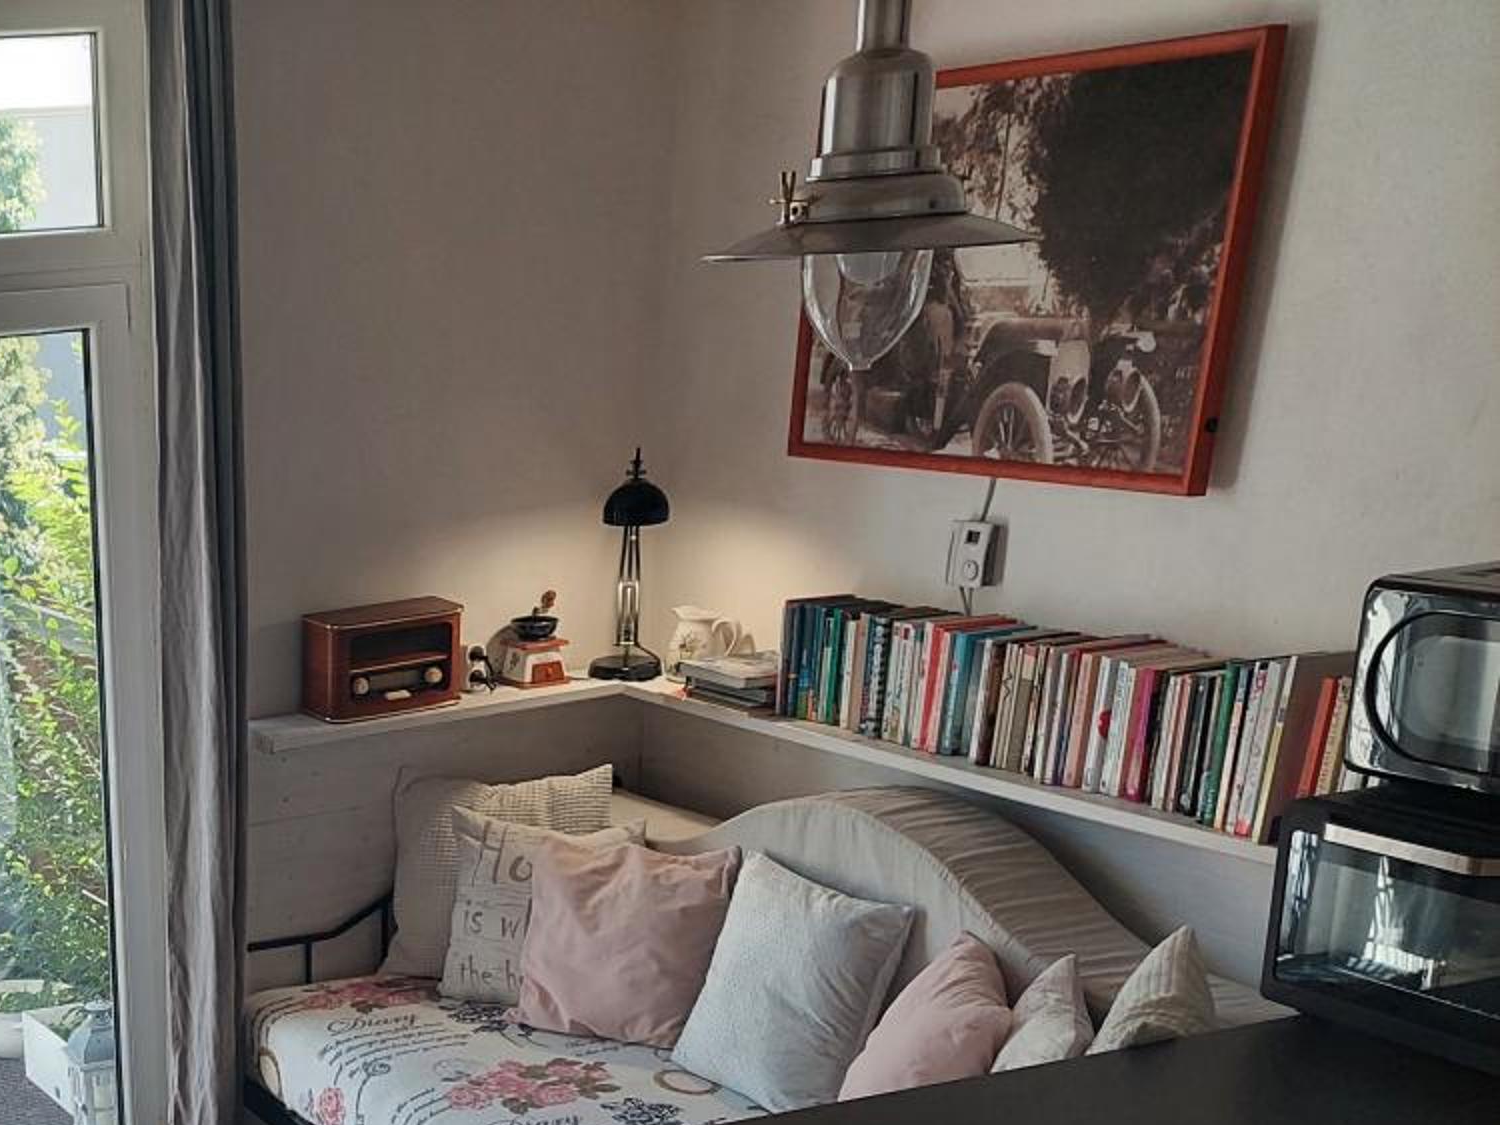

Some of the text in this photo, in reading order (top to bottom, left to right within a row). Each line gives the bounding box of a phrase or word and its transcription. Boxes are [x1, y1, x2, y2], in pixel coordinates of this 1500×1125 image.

[470, 820, 532, 885] Ho
[463, 900, 484, 934] is
[459, 955, 493, 990] the
